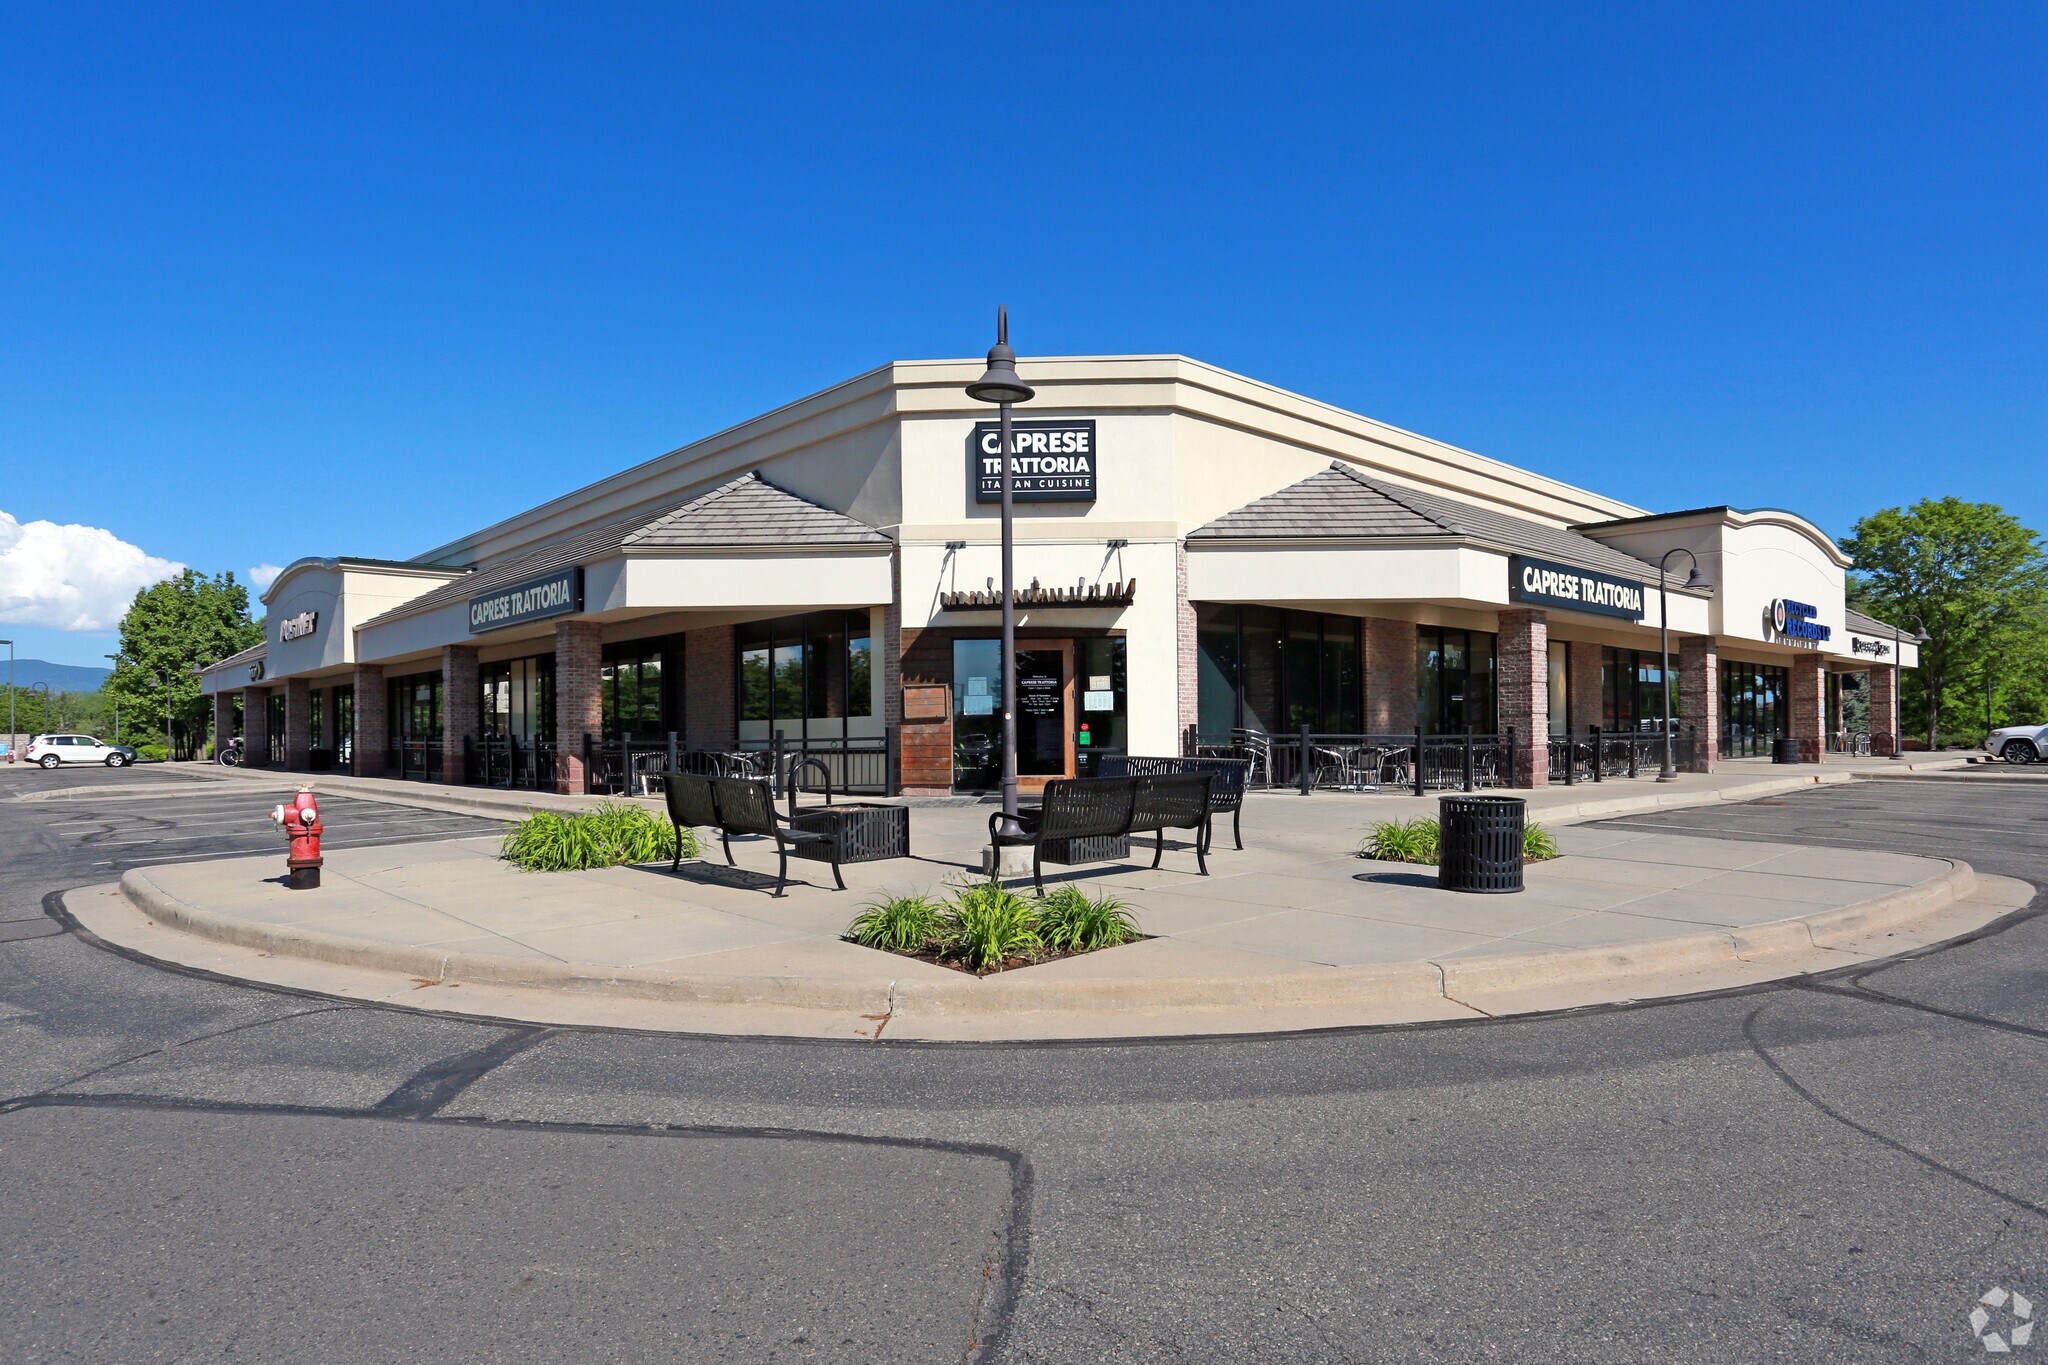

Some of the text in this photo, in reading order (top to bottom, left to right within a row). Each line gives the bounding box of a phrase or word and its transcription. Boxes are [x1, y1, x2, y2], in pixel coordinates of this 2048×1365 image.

[982, 457, 1090, 474] TRATTORIA
[982, 479, 1090, 488] ITAAN CUISINE
[1523, 566, 1642, 611] CAPRESE TRATTORIA
[471, 579, 570, 625] CAPRESE TRATTORIA
[1786, 599, 1817, 619] RECYCLED
[1786, 618, 1822, 640] RECORDS
